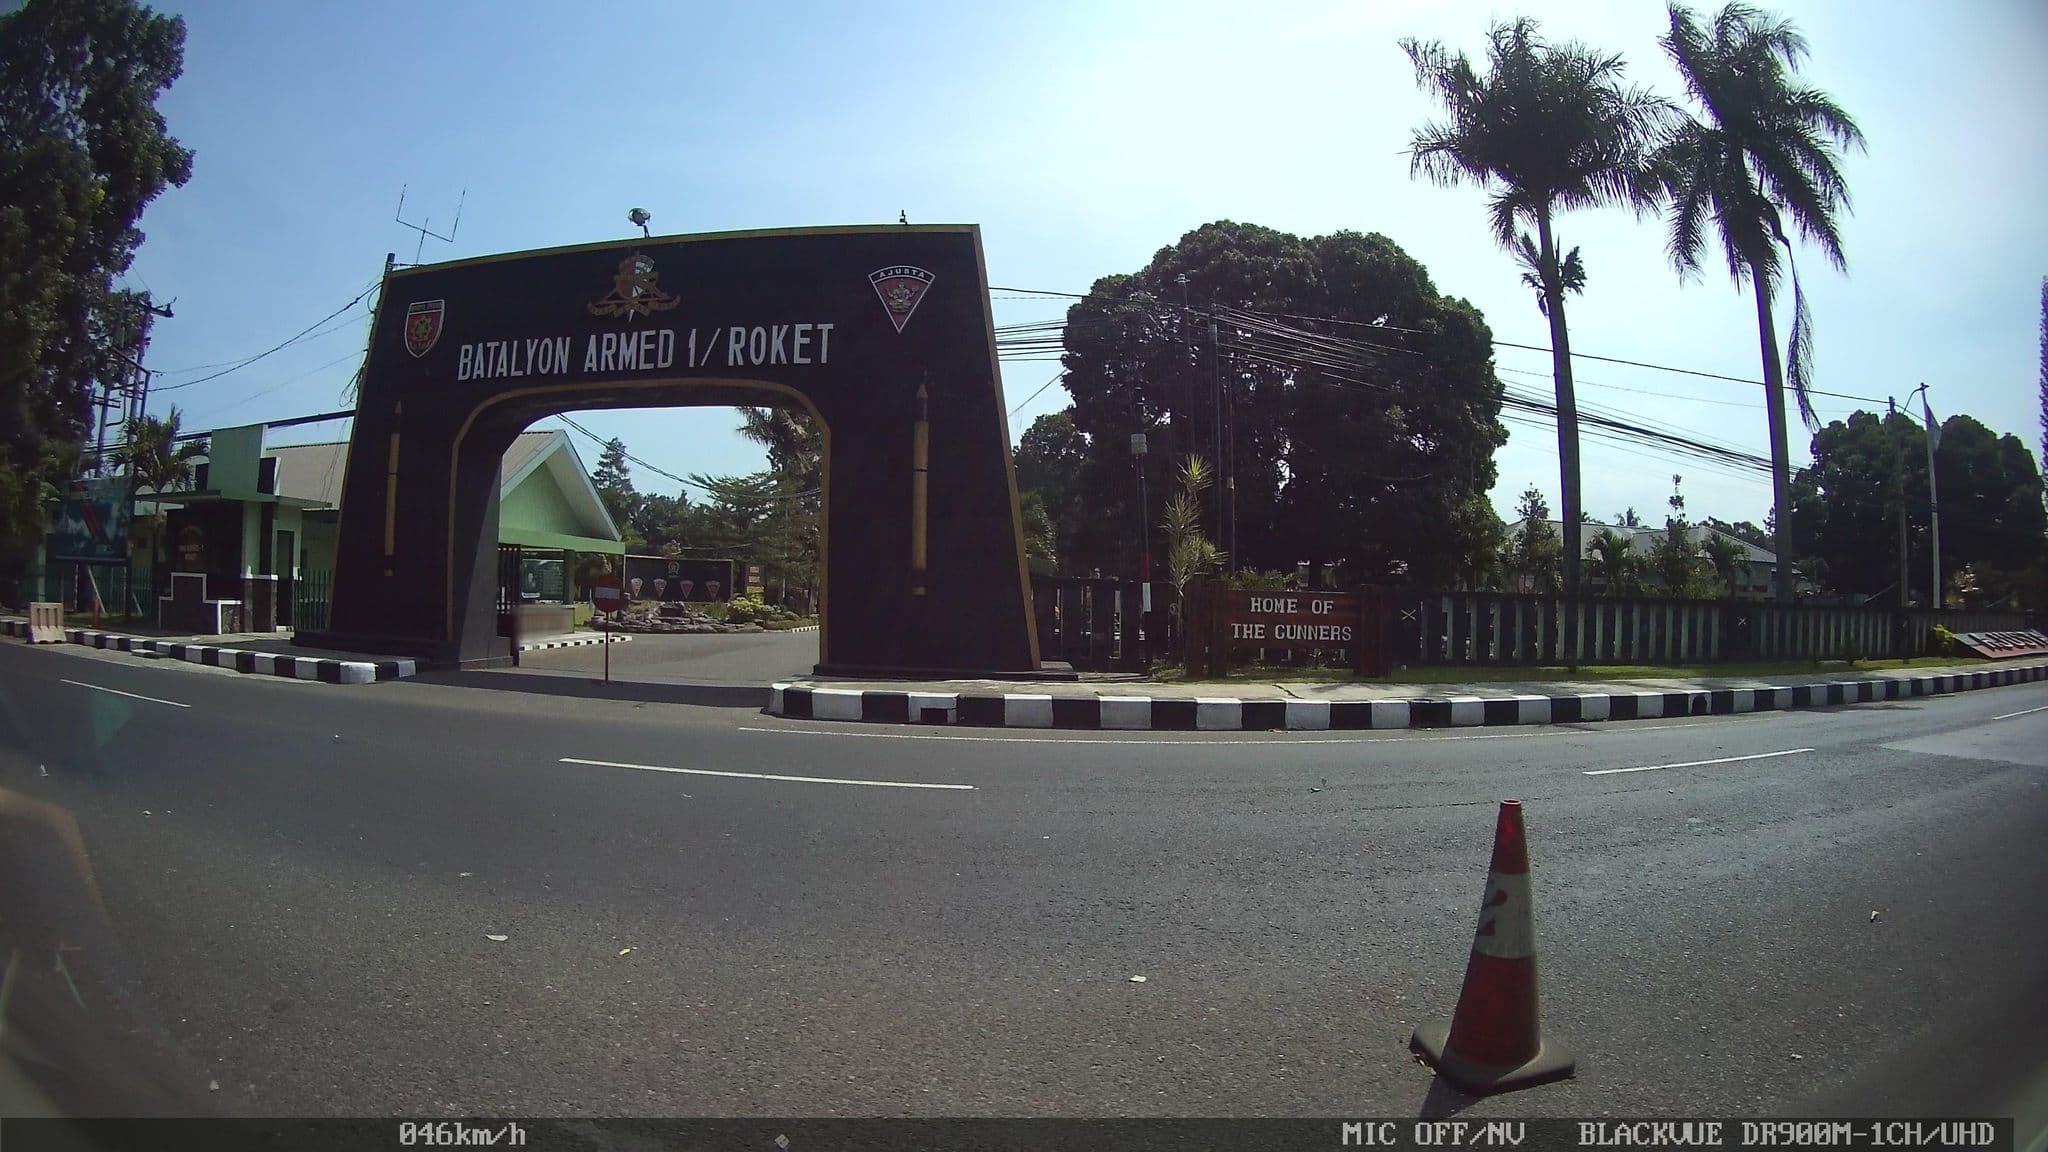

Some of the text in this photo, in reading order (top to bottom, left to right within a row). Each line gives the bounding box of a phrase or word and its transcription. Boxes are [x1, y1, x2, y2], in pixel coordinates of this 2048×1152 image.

[879, 267, 925, 279] AJUSTA
[457, 336, 571, 381] BATALYON
[583, 329, 675, 373] ARMED
[1250, 597, 1334, 615] HOME OF
[1231, 623, 1352, 642] THE GUNNERS
